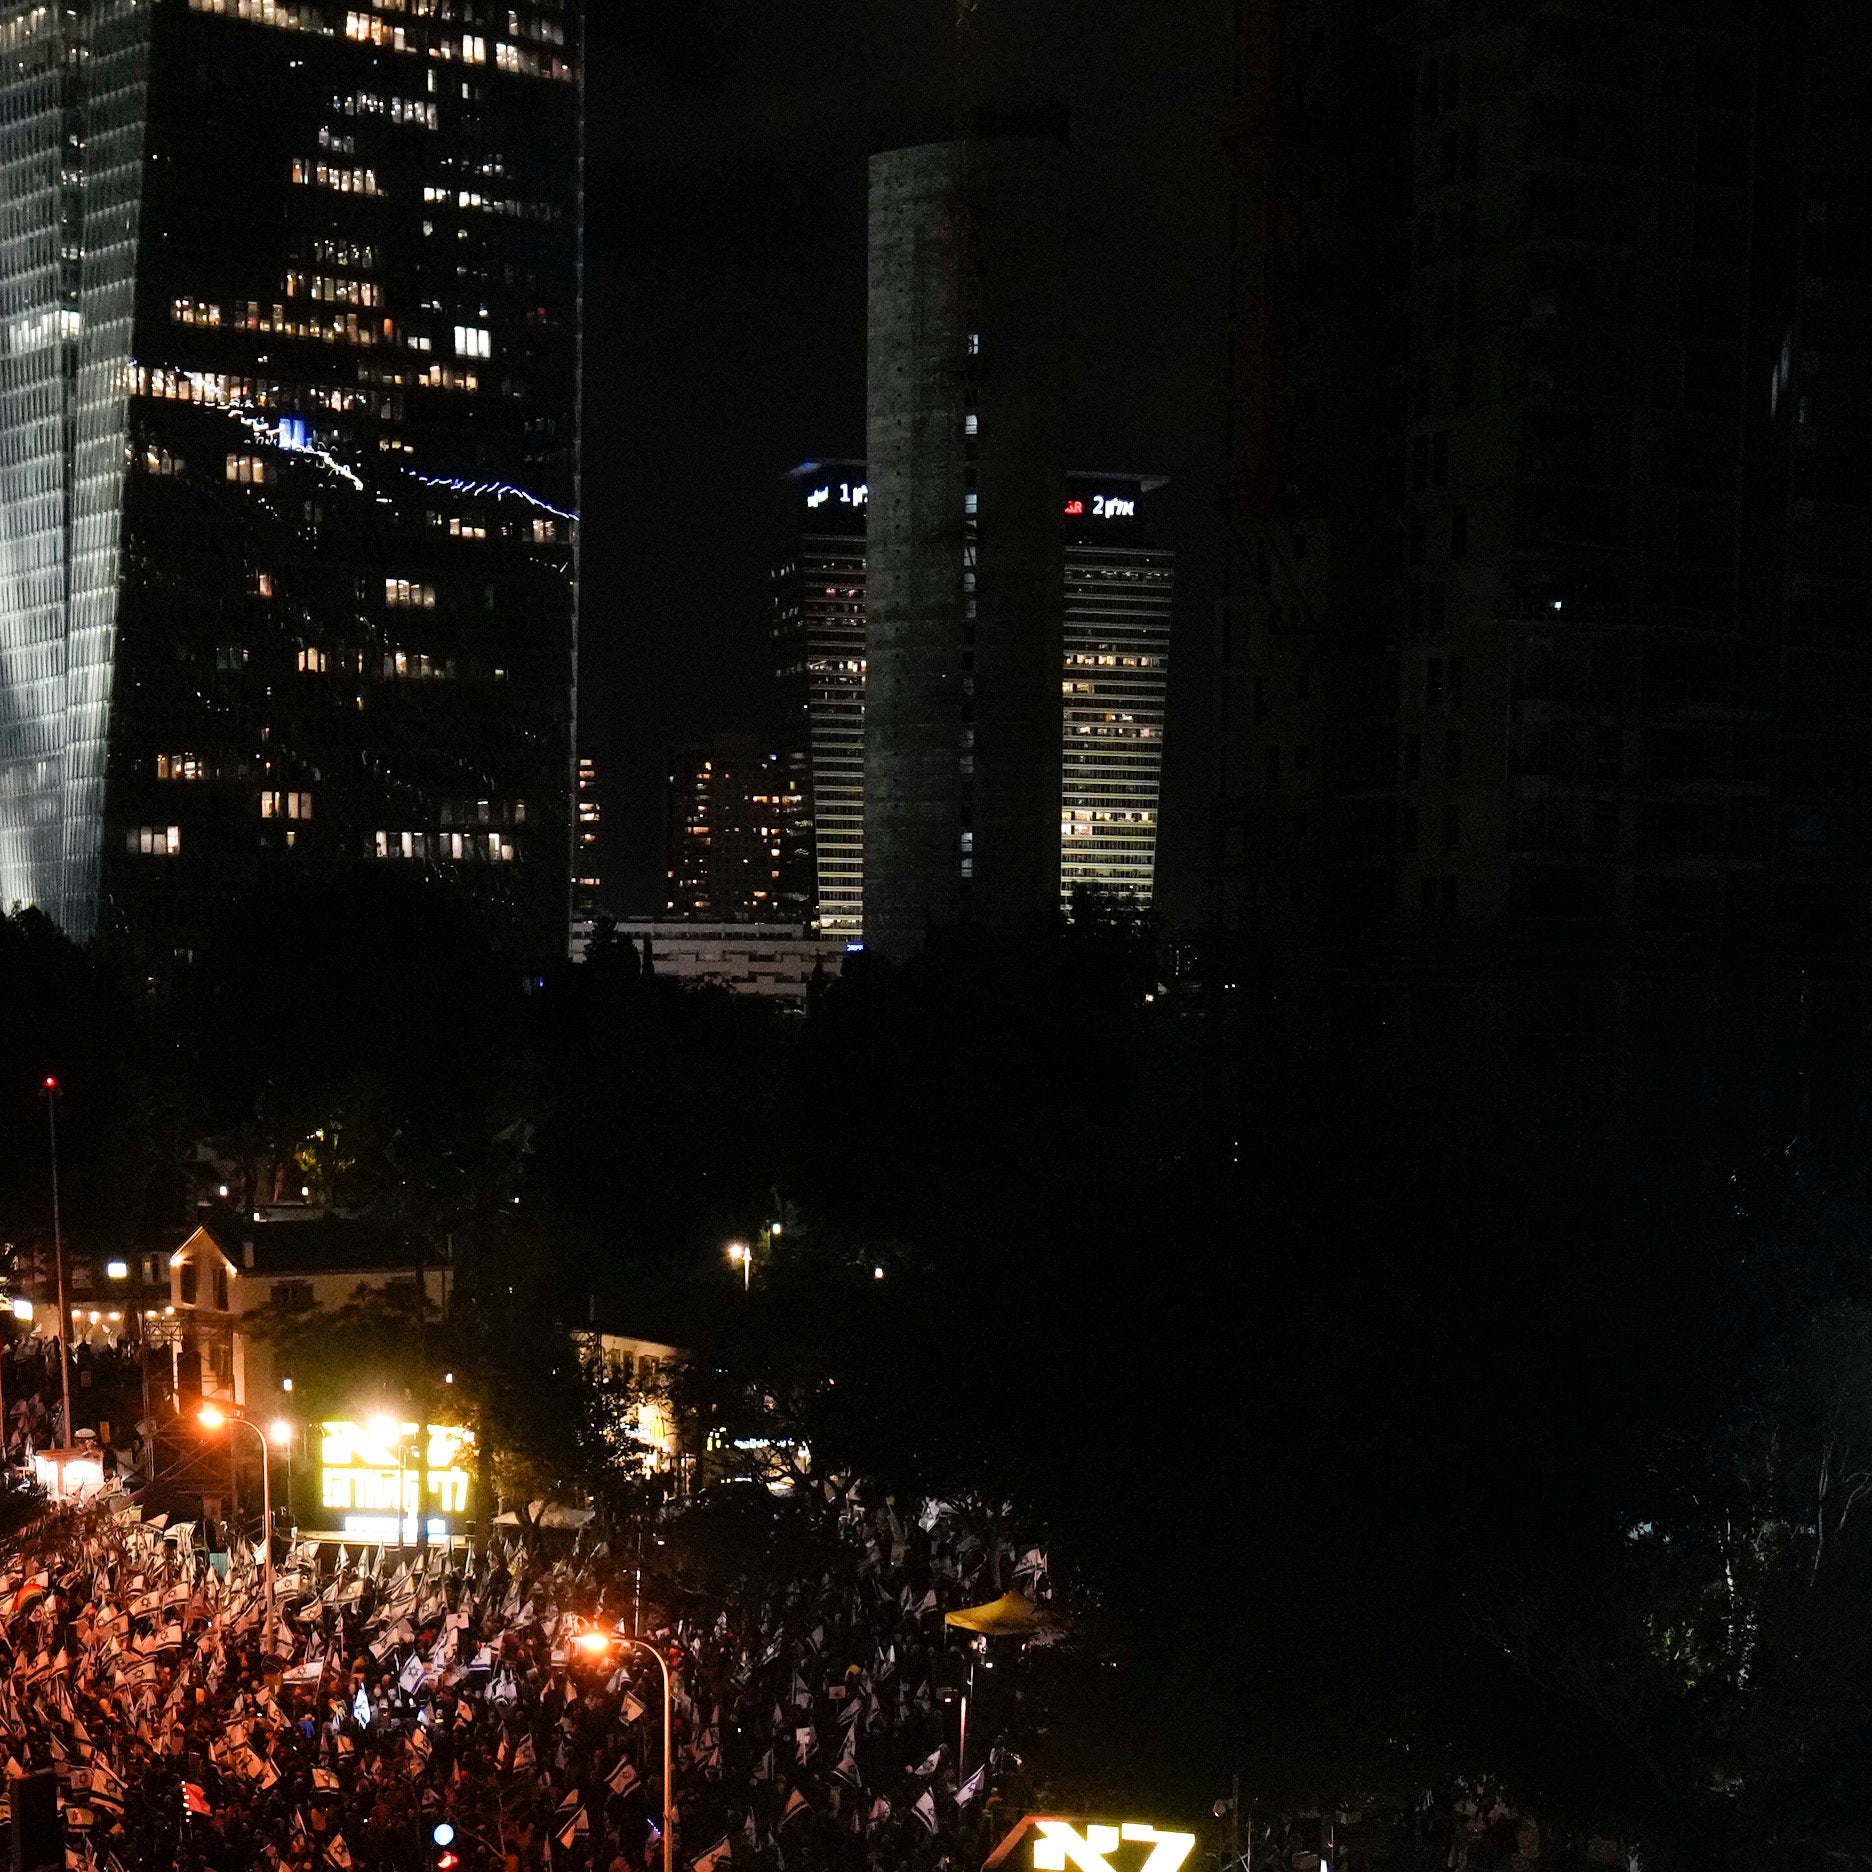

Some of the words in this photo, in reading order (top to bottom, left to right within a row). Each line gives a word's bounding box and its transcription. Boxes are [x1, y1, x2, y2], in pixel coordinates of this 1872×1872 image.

[840, 484, 851, 502] 1
[1092, 496, 1104, 514] 2
[1105, 498, 1134, 518] אלון
